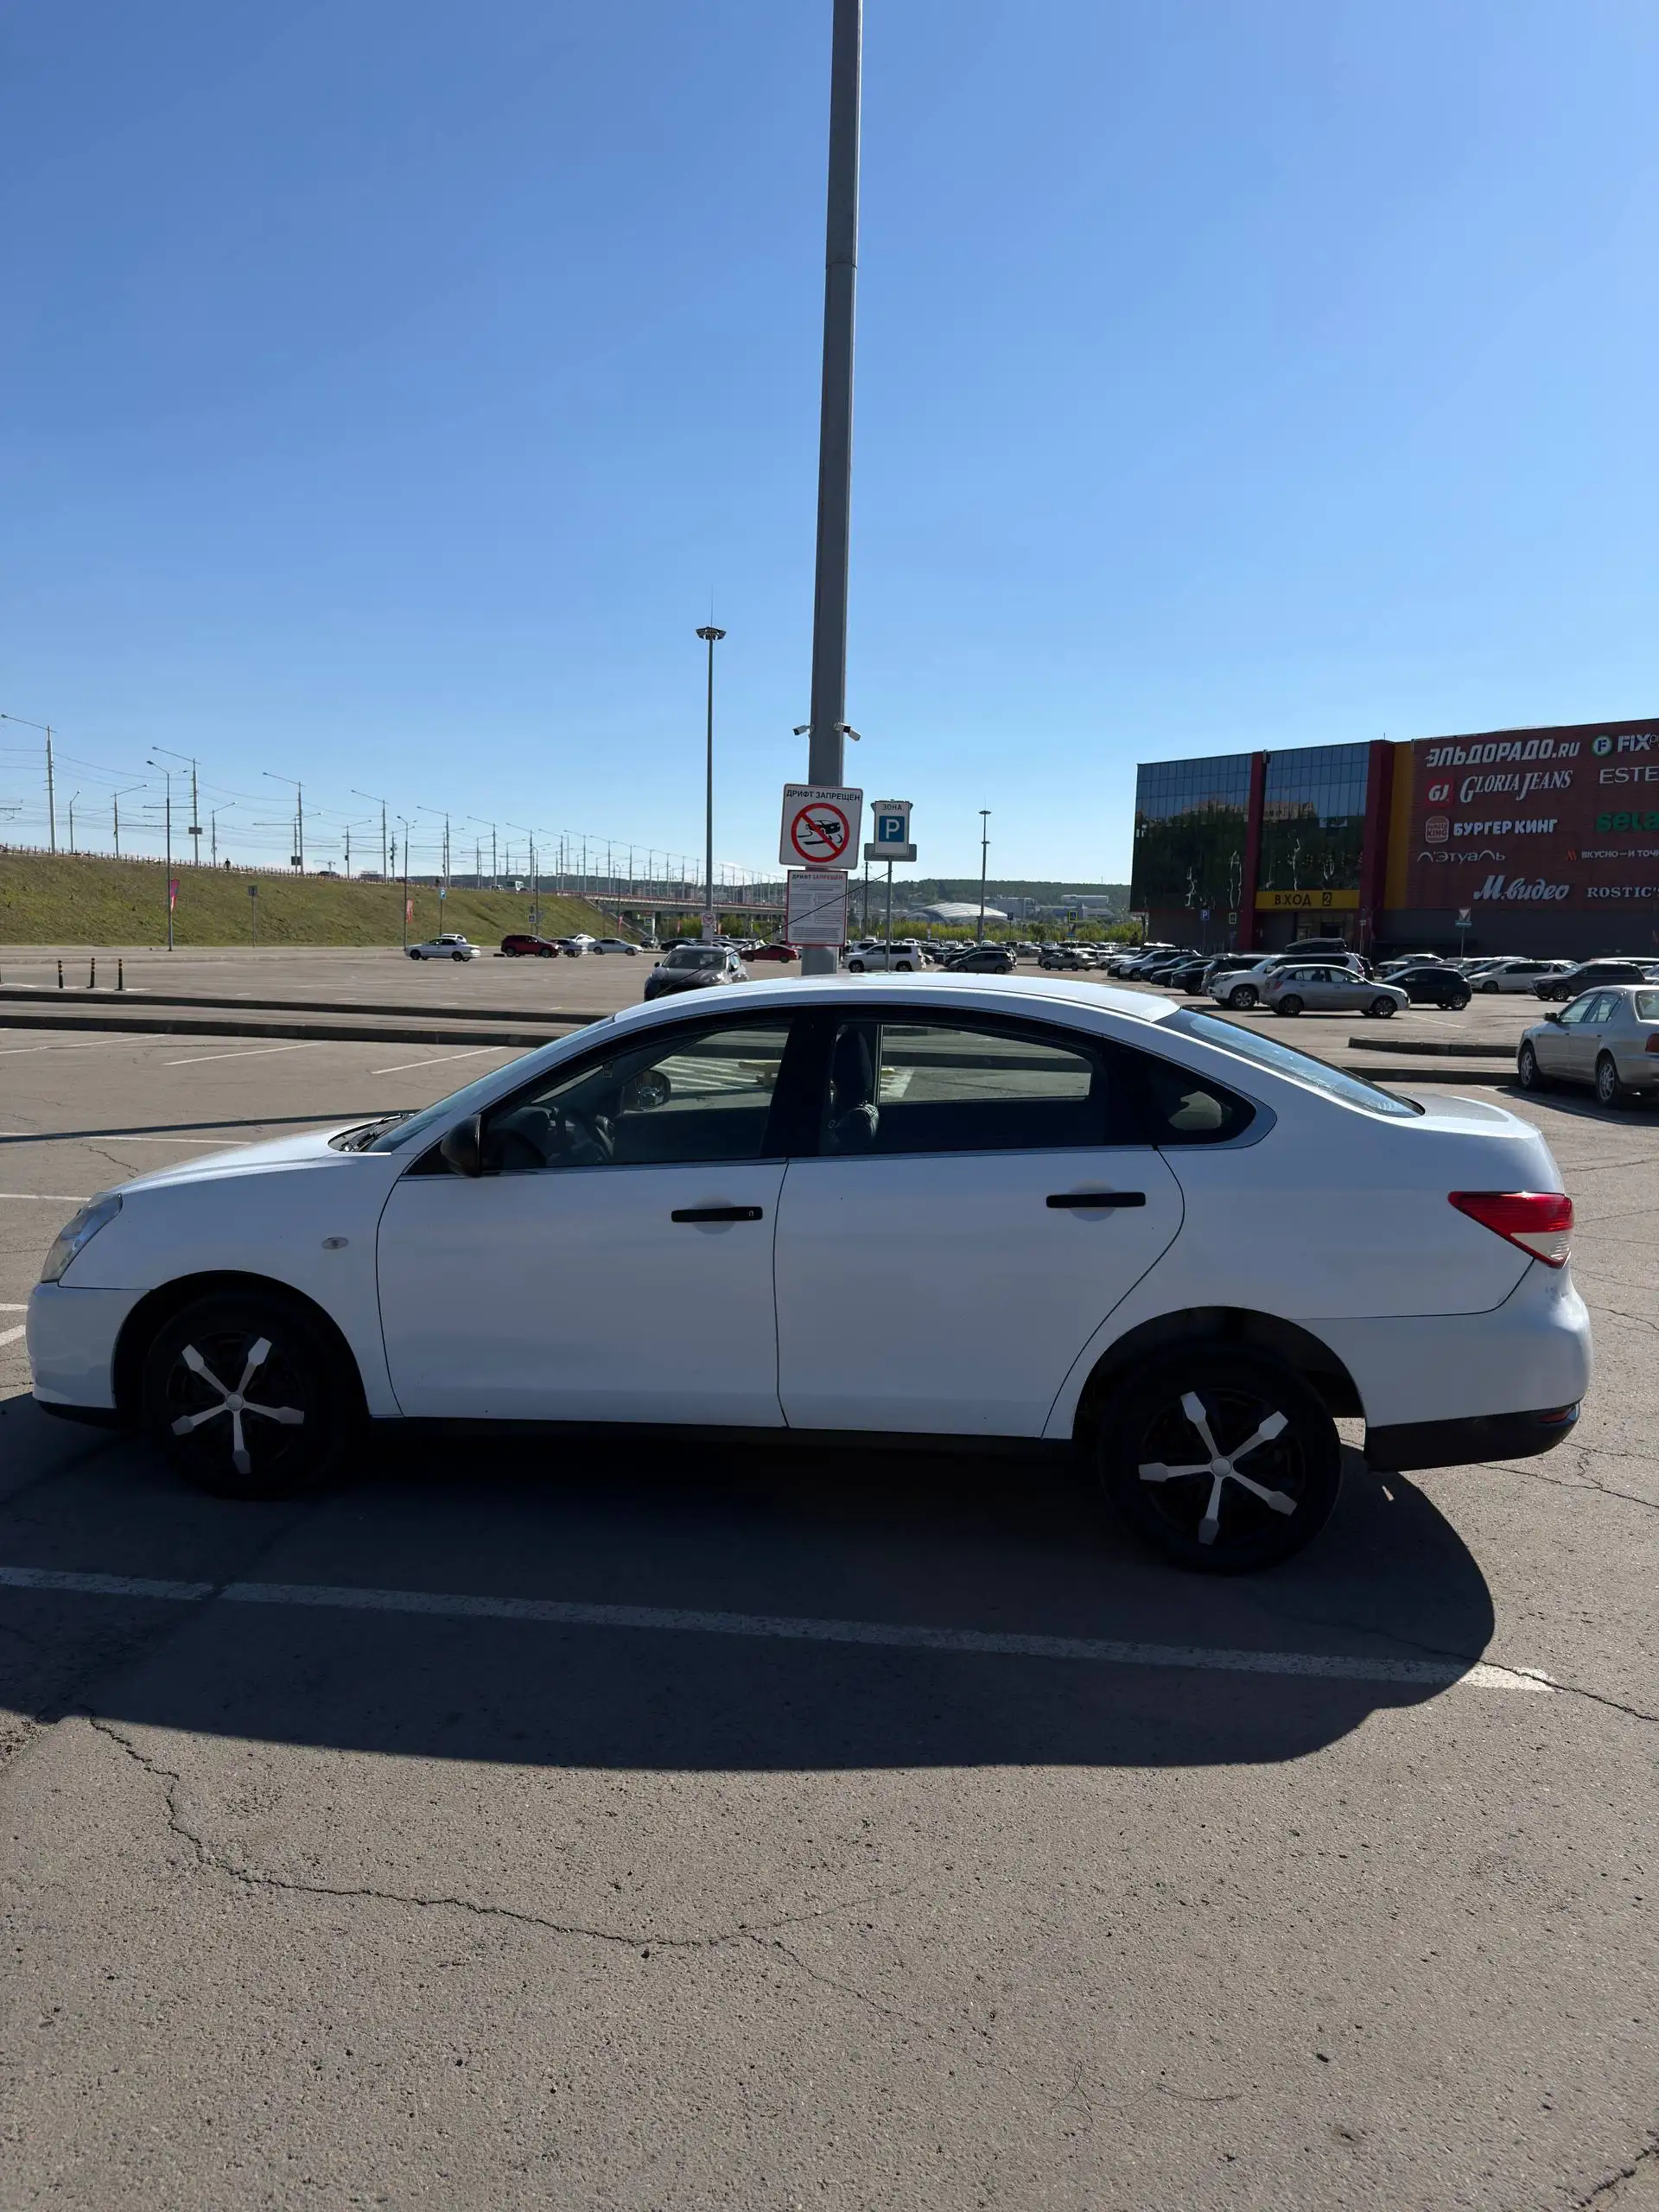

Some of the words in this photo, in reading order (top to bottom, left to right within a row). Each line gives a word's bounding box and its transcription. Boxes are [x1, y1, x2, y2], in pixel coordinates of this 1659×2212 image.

[786, 790, 813, 798] ДРИФТ
[816, 791, 860, 802] ЗАПРЕЩЕН
[1427, 784, 1449, 802] GJ
[1453, 821, 1511, 836] БУРГЕР
[1514, 819, 1558, 835] КИНГ
[1274, 894, 1311, 906] ВХОД
[1323, 893, 1332, 906] 2
